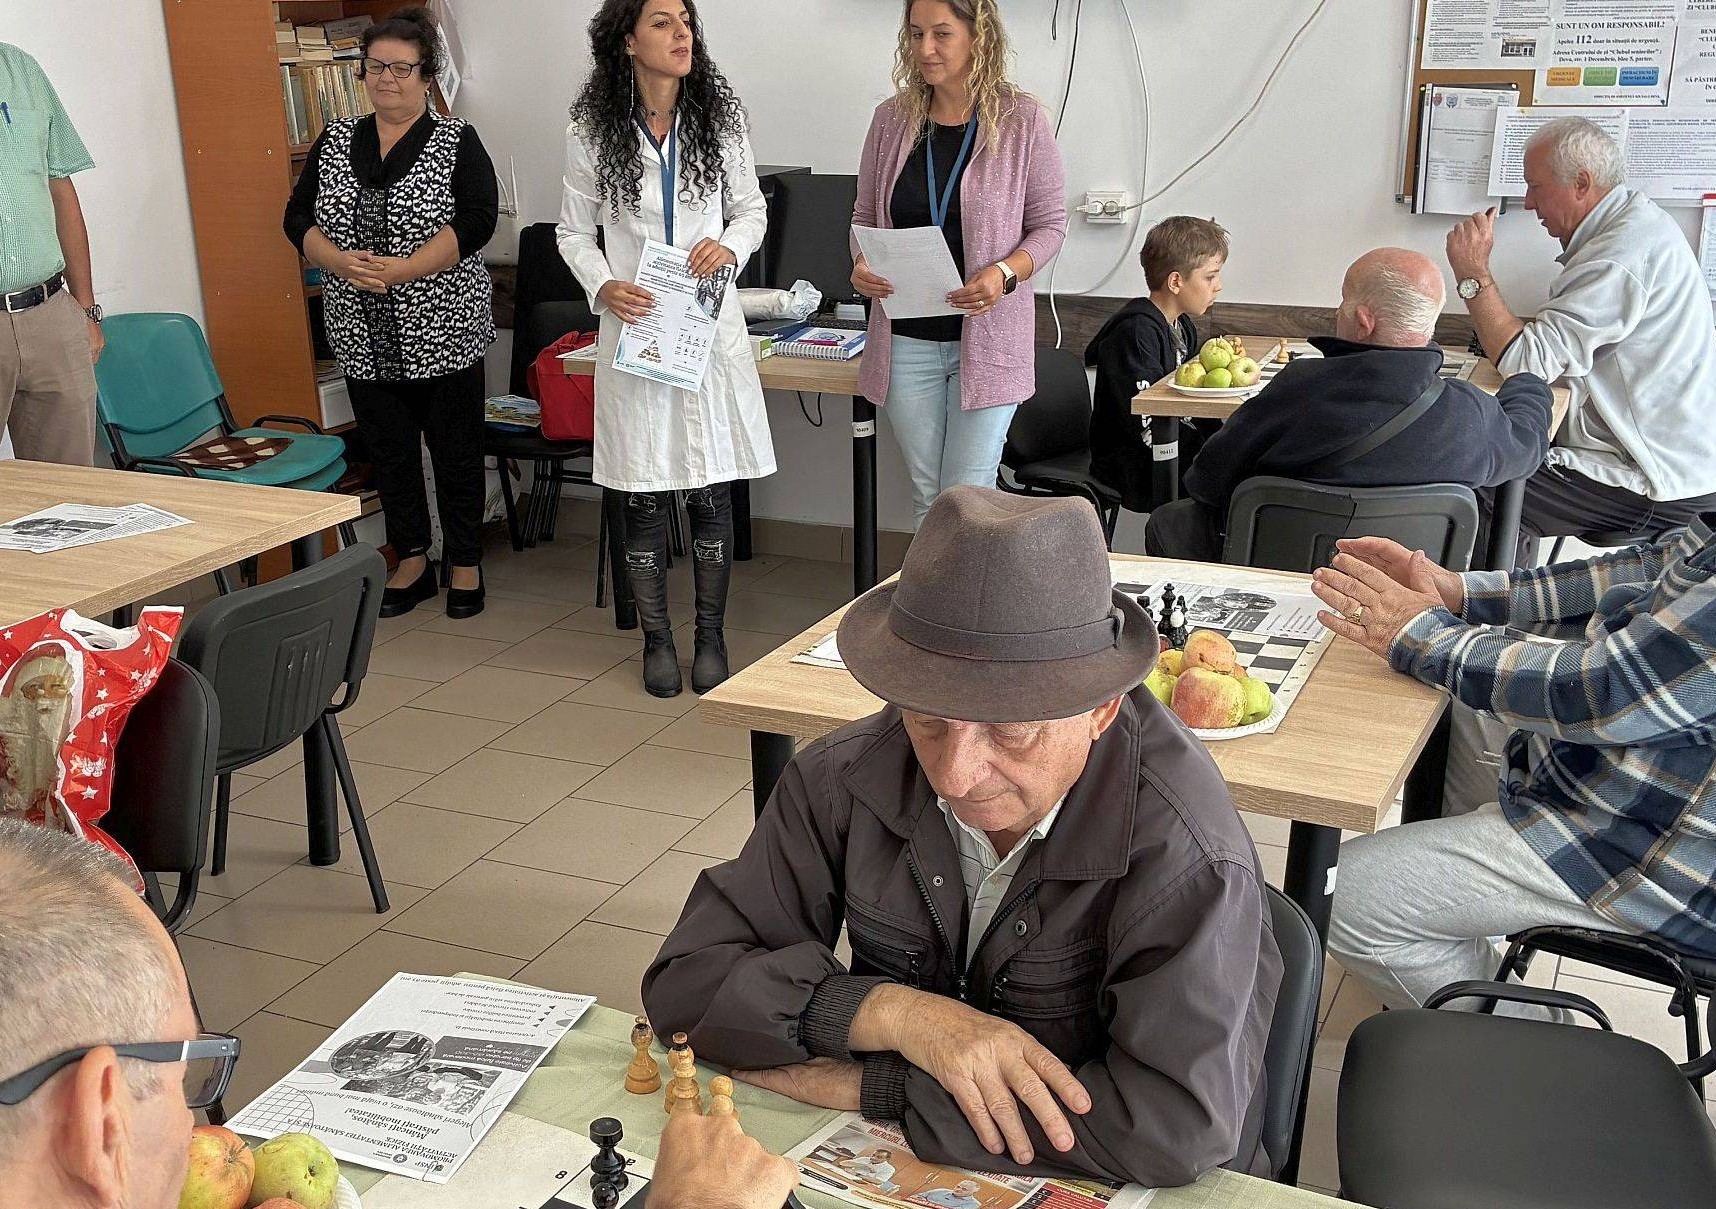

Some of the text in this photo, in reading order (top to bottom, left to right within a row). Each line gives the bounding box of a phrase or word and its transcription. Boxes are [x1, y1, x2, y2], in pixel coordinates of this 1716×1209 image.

[1576, 34, 1592, 44] 112
[344, 1108, 440, 1134] păstrați mobilitatea!
[352, 1114, 427, 1139] Mâncați sănătos,
[443, 1117, 470, 1128] Alegeri
[402, 1147, 454, 1163] PROMOVAREA
[555, 1170, 567, 1179] 8
